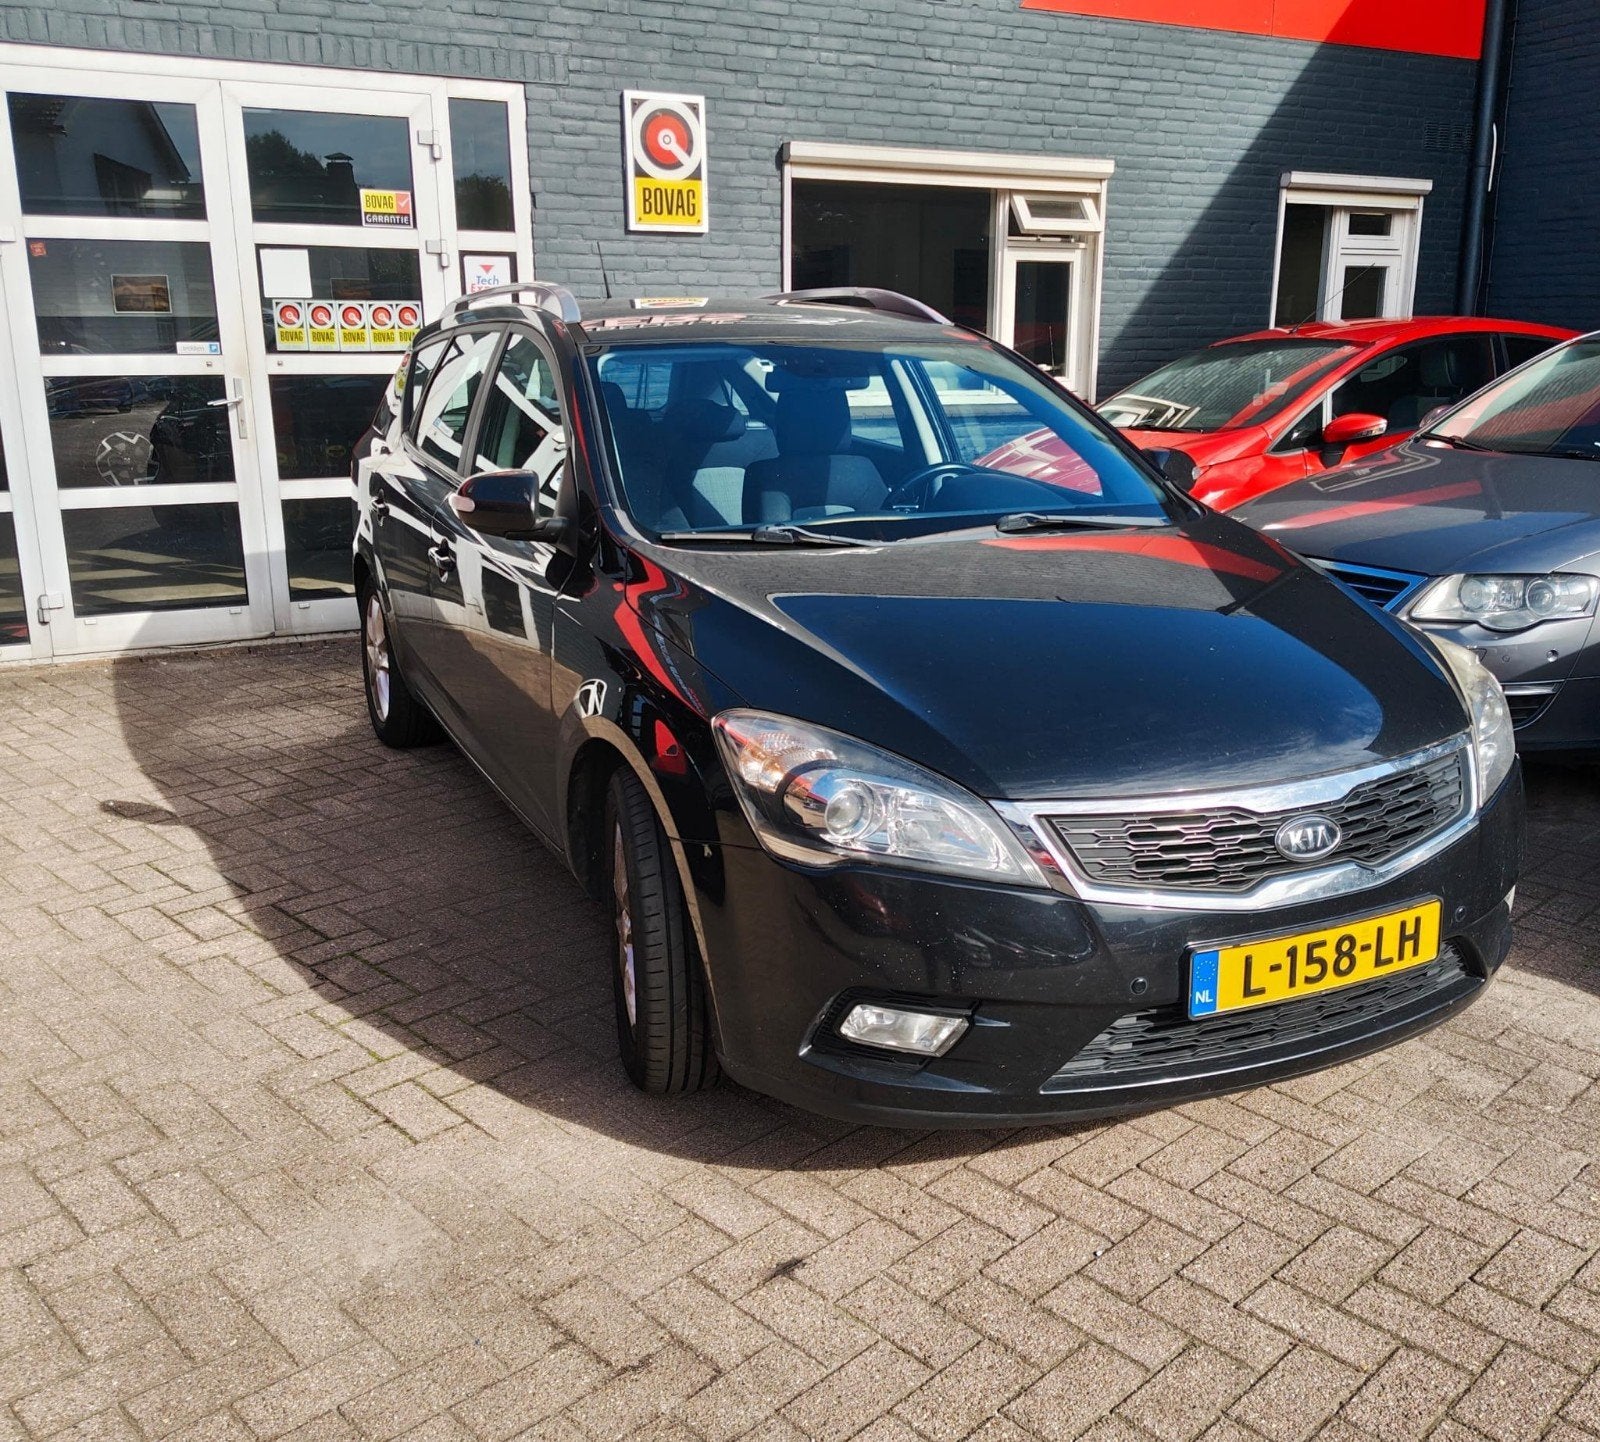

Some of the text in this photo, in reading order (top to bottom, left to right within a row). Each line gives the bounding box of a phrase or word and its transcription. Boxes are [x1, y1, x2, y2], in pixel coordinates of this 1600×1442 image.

[365, 194, 394, 209] BOVAG
[642, 187, 696, 216] BOVAG
[366, 214, 410, 224] GARANTIE
[475, 275, 500, 285] Tech
[280, 331, 304, 342] BOVAG
[312, 331, 334, 342] BOVAG
[343, 332, 366, 342] BOVAG
[373, 332, 395, 342] BOVAG
[1287, 824, 1333, 853] KIA
[1243, 916, 1421, 999] L-158-LH
[1195, 990, 1213, 1005] NL
